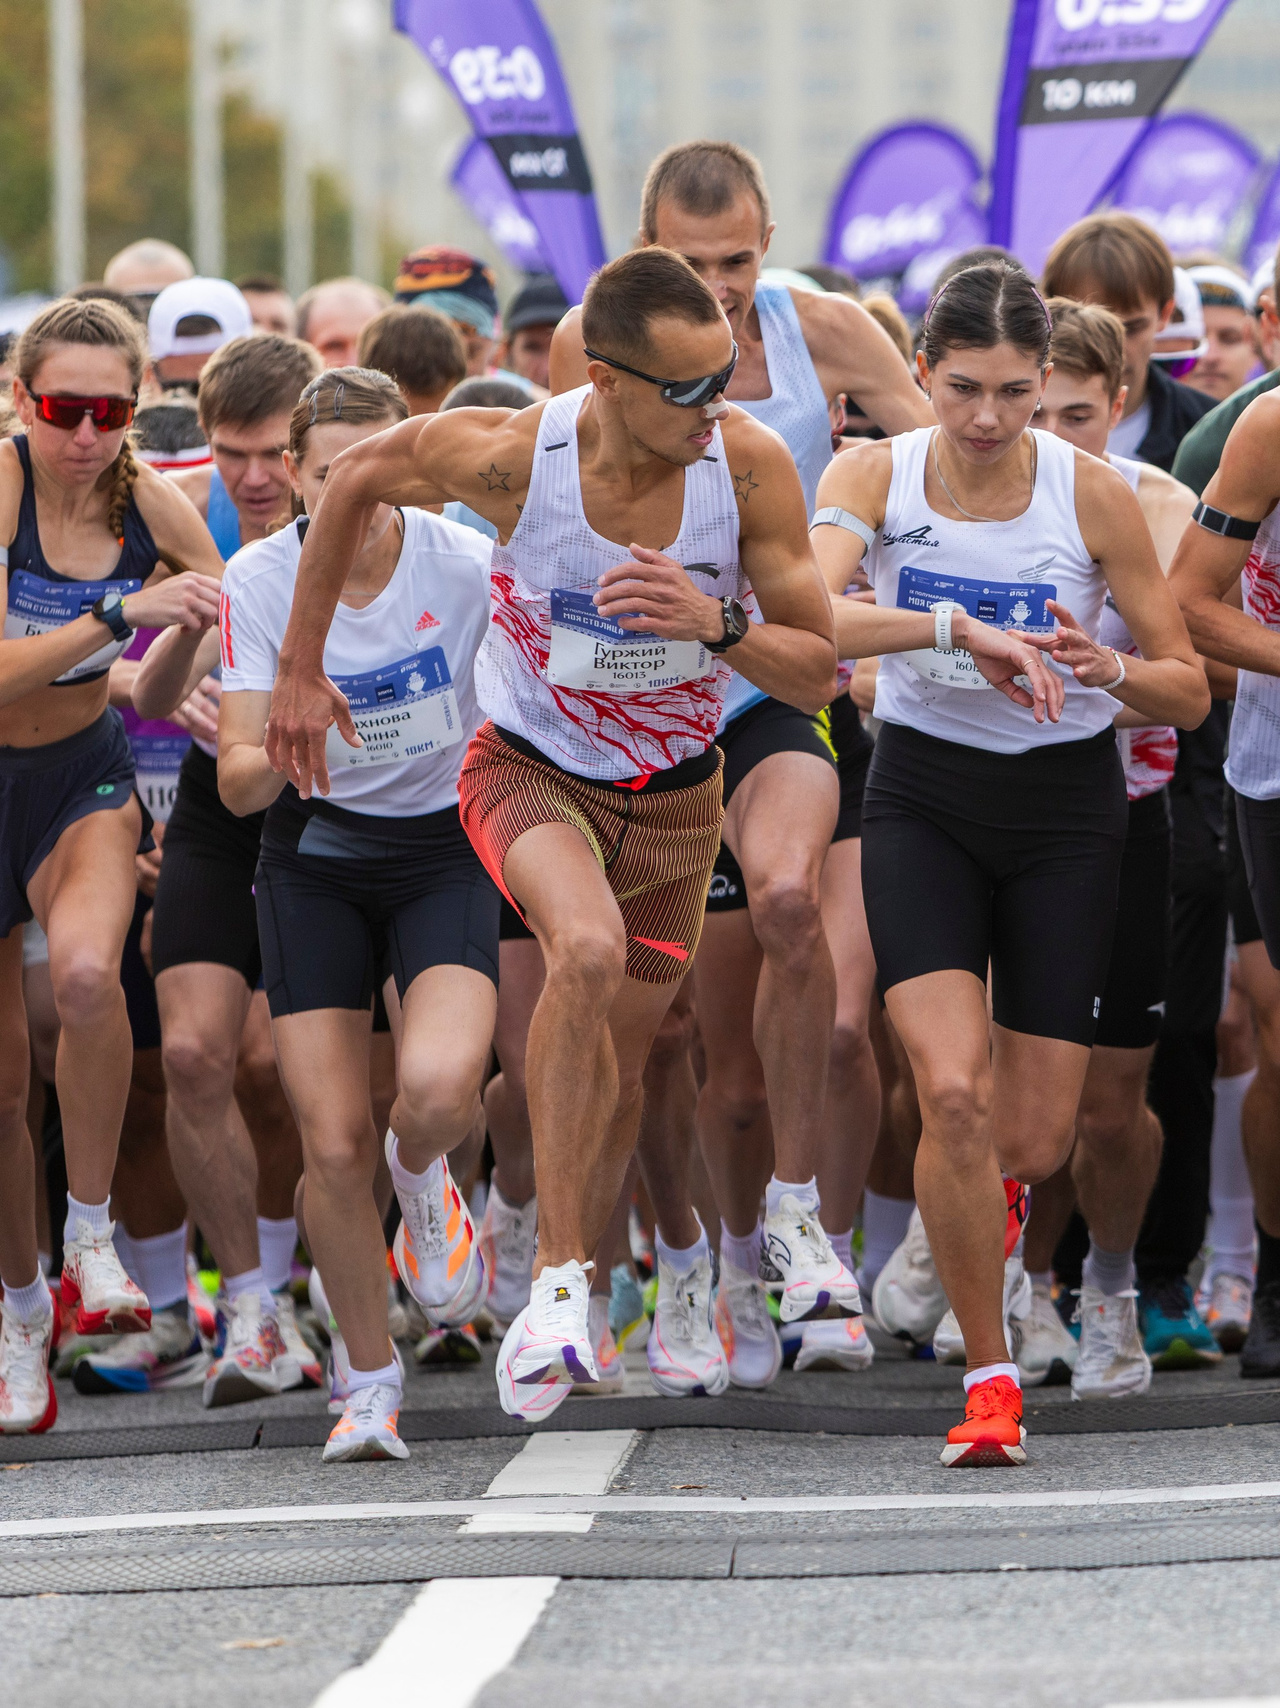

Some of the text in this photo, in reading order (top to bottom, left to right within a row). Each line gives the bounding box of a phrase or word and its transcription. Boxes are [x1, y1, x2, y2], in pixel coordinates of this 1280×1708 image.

[1042, 78, 1082, 111] 10
[15, 599, 32, 612] МОЯ
[33, 603, 72, 616] СТОЛИЦА
[908, 596, 926, 607] МОЯ
[563, 612, 624, 635] МОЯ СТОЛИЦА
[594, 642, 666, 661] Гуржий
[594, 657, 666, 671] Виктор
[955, 660, 980, 672] 1601
[613, 671, 646, 679] 16013
[366, 741, 393, 752] 16010
[147, 786, 178, 808] 110
